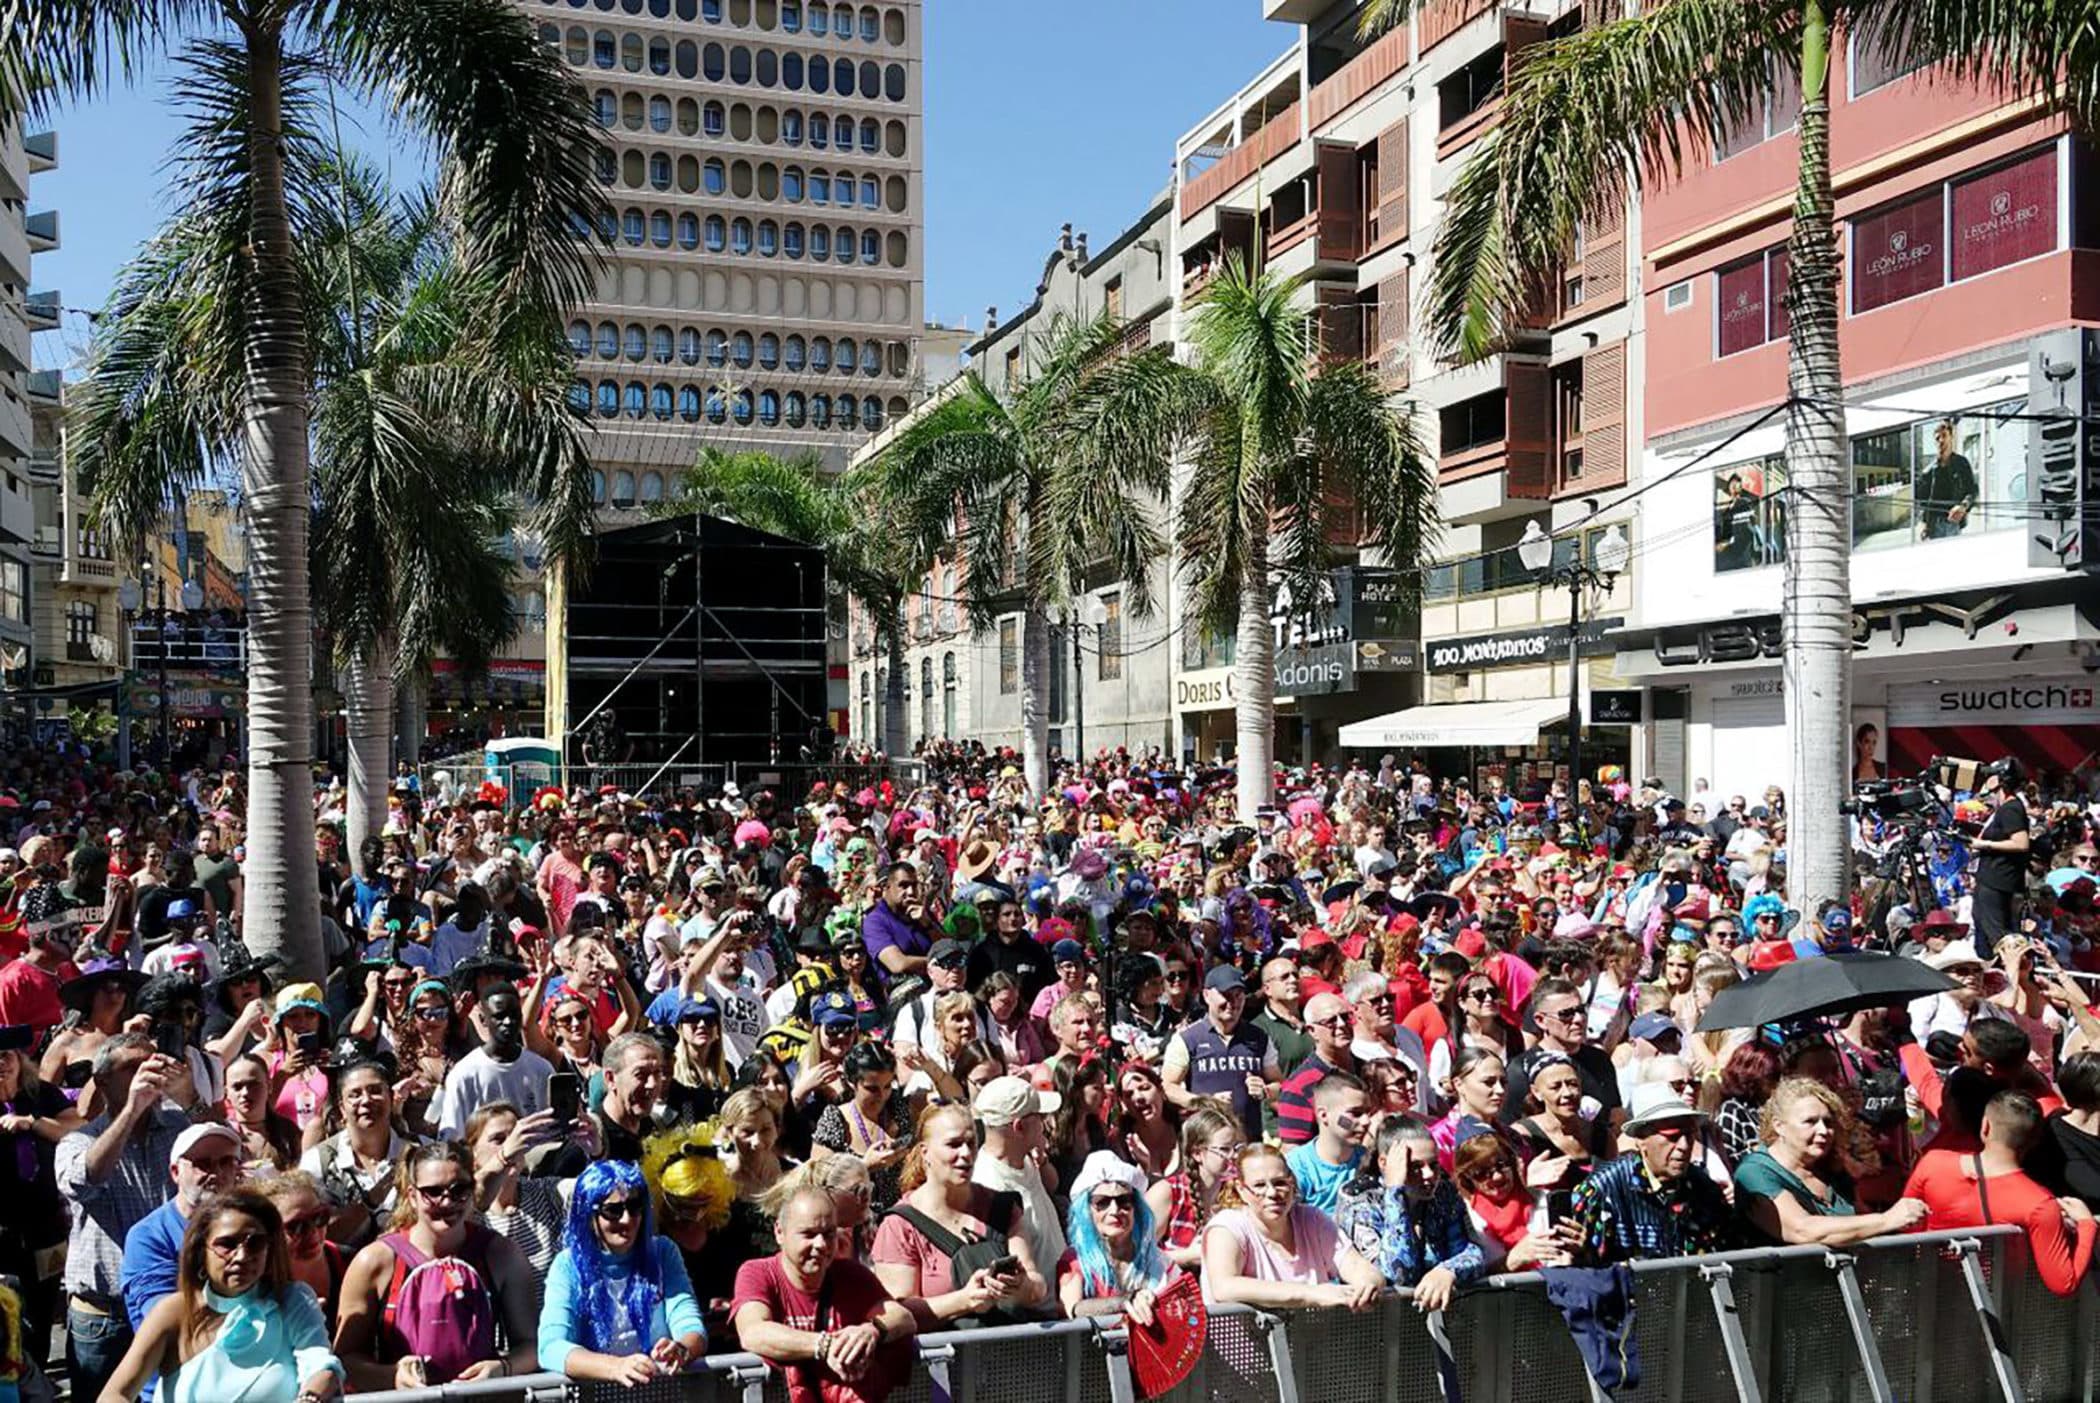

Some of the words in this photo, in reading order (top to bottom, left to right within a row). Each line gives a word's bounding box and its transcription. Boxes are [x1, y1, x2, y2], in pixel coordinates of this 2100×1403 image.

[1433, 647, 1459, 666] 100
[1460, 636, 1546, 664] MONTADITOS
[1940, 685, 2066, 711] swatch
[1198, 1056, 1261, 1072] HACKETT
